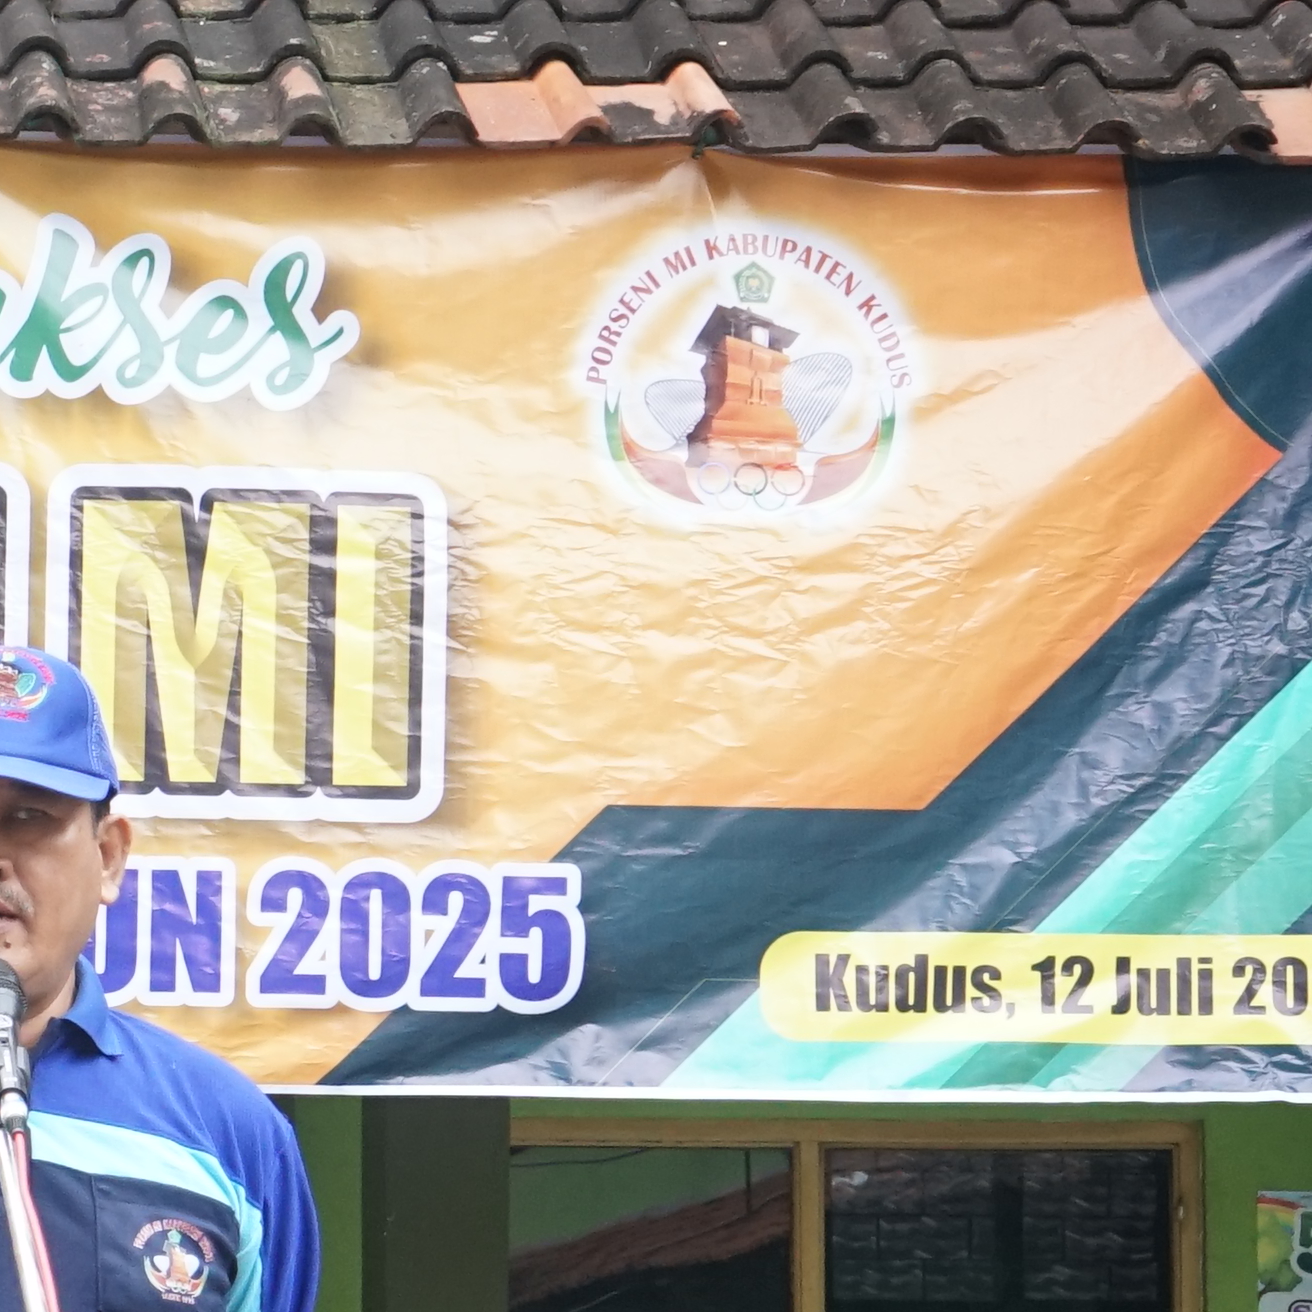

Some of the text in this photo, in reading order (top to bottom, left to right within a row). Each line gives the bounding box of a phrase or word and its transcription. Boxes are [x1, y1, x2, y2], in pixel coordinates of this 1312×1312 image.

[585, 231, 913, 391] PORSENI MI KABUPATEN KUDUS
[67, 485, 425, 801] MI
[257, 867, 579, 1002] 2025
[813, 952, 1016, 1021] Kudus,
[1031, 953, 1096, 1016] 12
[1109, 955, 1215, 1017] Juli
